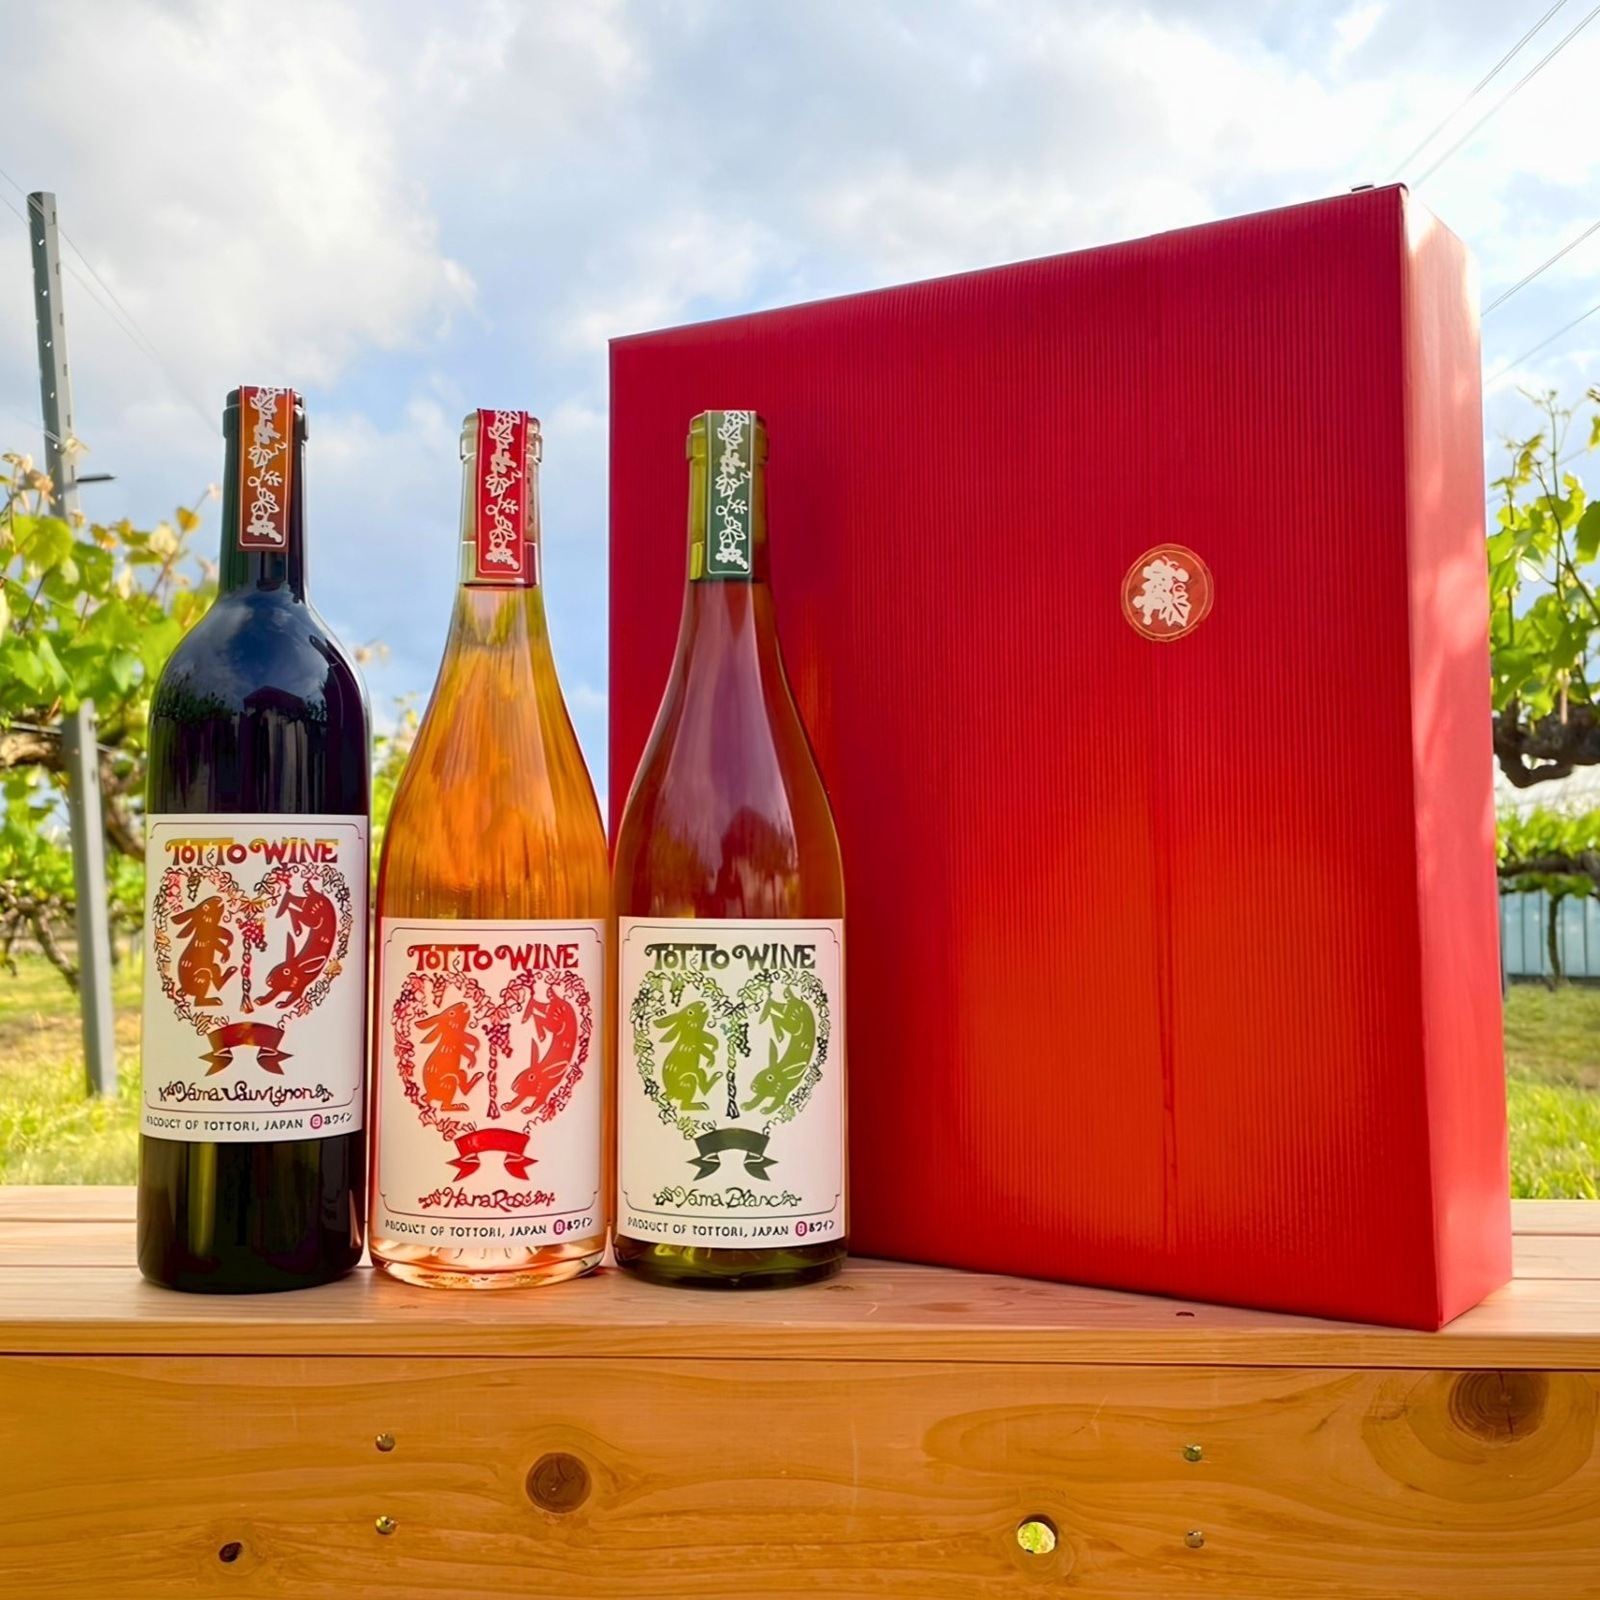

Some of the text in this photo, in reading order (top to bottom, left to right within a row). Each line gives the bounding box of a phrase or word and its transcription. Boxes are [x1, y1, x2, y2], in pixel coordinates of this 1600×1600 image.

[165, 836, 339, 866] TOTTO WINE
[407, 943, 579, 972] TOTTO WINE
[644, 943, 816, 971] TOTTO WINE
[204, 1121, 259, 1132] TOTTORI,
[264, 1118, 303, 1131] JAPAN
[725, 1187, 779, 1209] Blanc
[449, 1226, 505, 1238] TOTTORI,
[510, 1224, 547, 1236] JAPAN
[673, 1224, 687, 1234] OF
[692, 1225, 748, 1238] TOTTORI,
[752, 1225, 789, 1237] JAPAN
